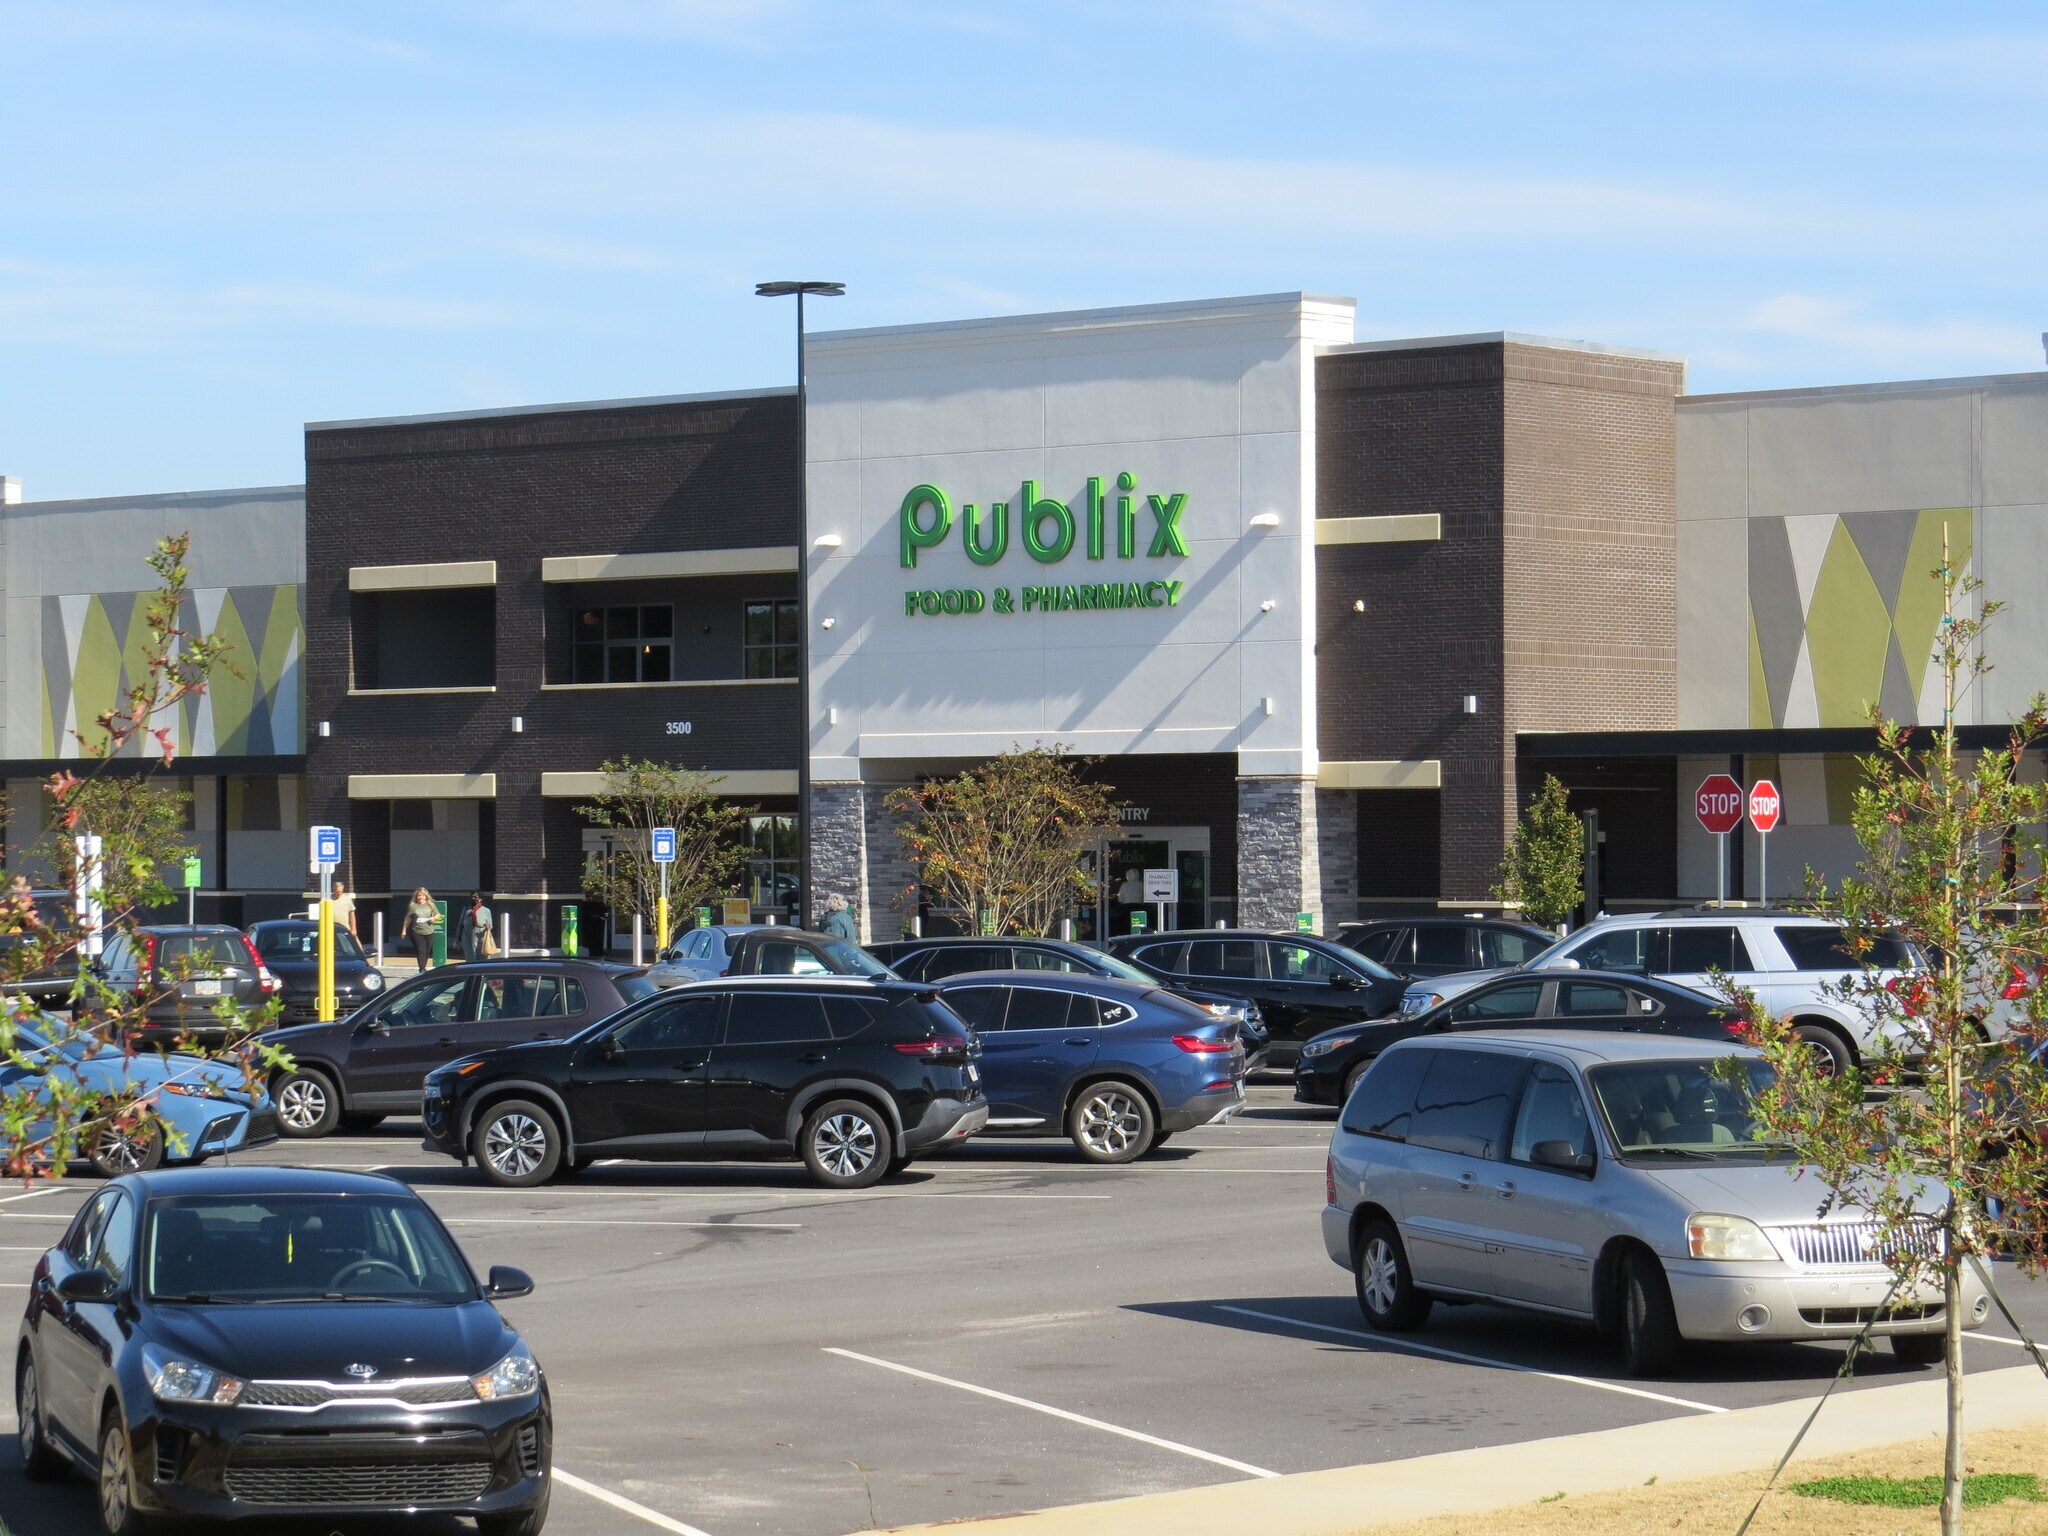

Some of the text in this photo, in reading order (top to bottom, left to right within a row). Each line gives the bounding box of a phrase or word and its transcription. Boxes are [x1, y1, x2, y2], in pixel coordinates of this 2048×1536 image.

[900, 471, 1190, 568] Publix
[904, 580, 1184, 616] FOOD & PHARMACY
[666, 721, 692, 734] 3500
[1699, 793, 1740, 815] STOP
[1751, 796, 1777, 815] STOP
